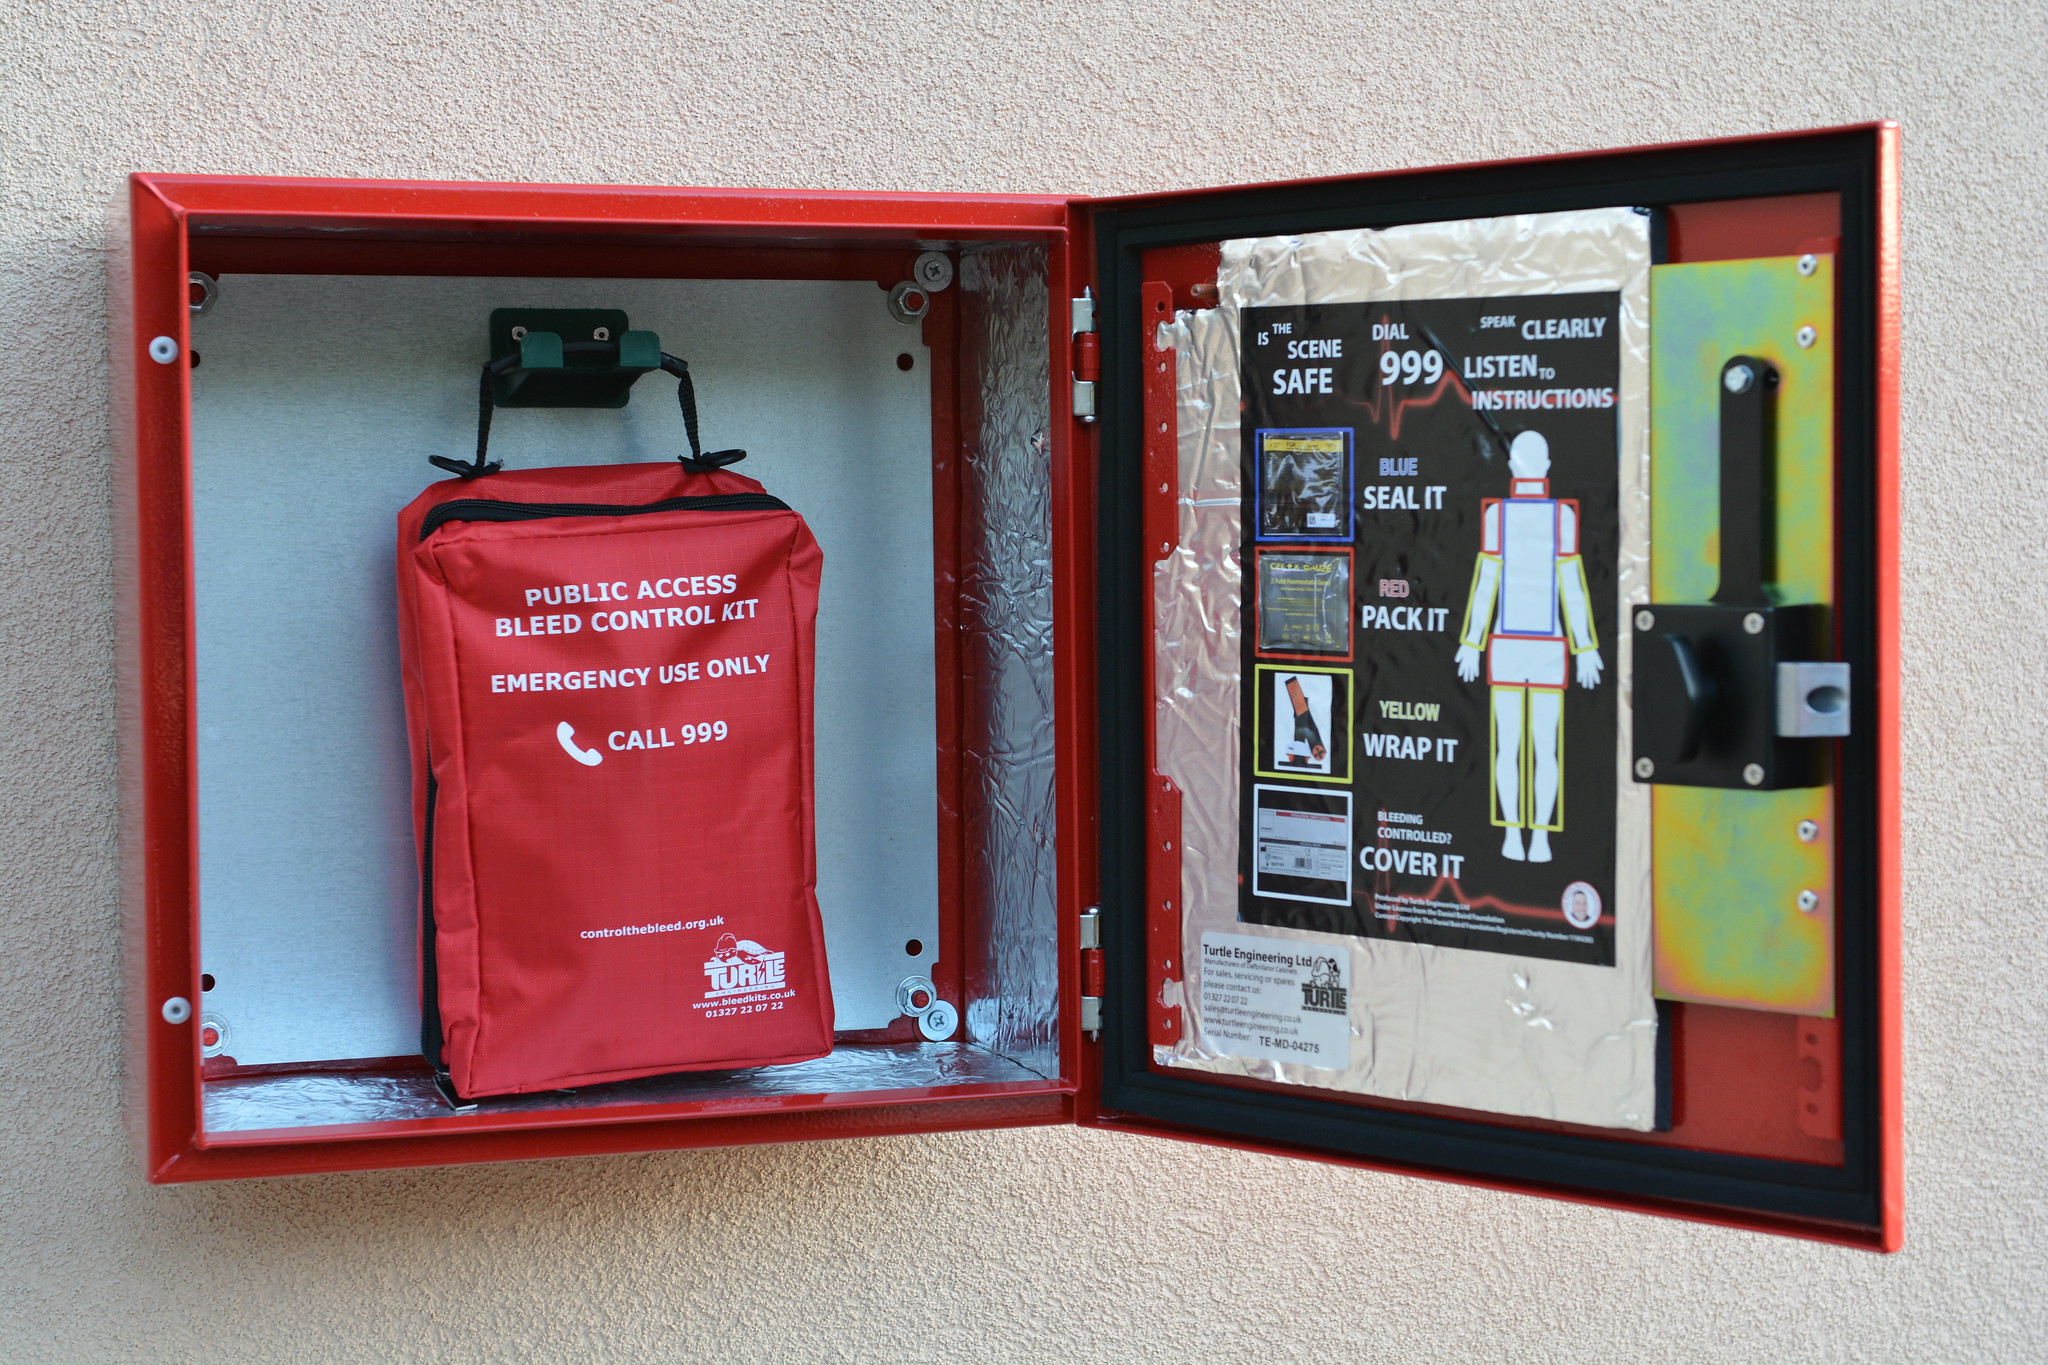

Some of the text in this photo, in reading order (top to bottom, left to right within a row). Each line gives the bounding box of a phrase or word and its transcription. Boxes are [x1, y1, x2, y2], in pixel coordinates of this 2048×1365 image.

[1257, 323, 1292, 346] IS THE
[1372, 323, 1409, 341] DIAL
[1480, 315, 1607, 341] SPEAK CLEARLY
[1287, 339, 1342, 359] SCENE
[1380, 349, 1444, 386] 999
[1463, 354, 1555, 381] LISTEN TO
[1272, 367, 1333, 396] SAFE
[1472, 387, 1614, 411] INSTRUCTIONS
[1379, 457, 1418, 476] BLUE
[1364, 485, 1447, 510] SEAL IT
[525, 574, 737, 607] PUBLIC ACCESS
[1379, 579, 1410, 598] RED
[495, 599, 758, 637] BLEED CONTROL KIT
[1362, 605, 1449, 632] PACK IT
[491, 654, 770, 693] EMERGENCY USE ONLY
[1379, 700, 1440, 722] YELLOW
[608, 720, 728, 751] CALL 999
[1363, 732, 1458, 763] WRAP IT
[1377, 810, 1423, 825] BLEEDING
[1377, 826, 1453, 845] CONTROLLED?
[1360, 846, 1437, 877] COVER
[1442, 854, 1465, 880] IT
[1374, 893, 1401, 902] Produced
[1402, 896, 1409, 904] by
[1409, 897, 1425, 905] Turtle
[1426, 899, 1460, 910] Engineering
[580, 915, 724, 939] controlthebleed.org.uk
[1203, 944, 1312, 968] Turtle Engineering Ltd
[1204, 957, 1239, 968] Manufacturers
[704, 957, 786, 990] TURTLE
[1203, 967, 1214, 976] For
[1215, 970, 1232, 979] sales,
[1234, 972, 1263, 984] servicing
[1273, 978, 1295, 987] spares
[1203, 980, 1262, 994] please contact us:
[1204, 992, 1248, 1005] 01327 22 07 22
[1302, 988, 1347, 1009] TURTLE
[692, 989, 795, 1009] www.bleedkits.co.uk
[706, 1001, 784, 1018] 01327 22 07 22
[1204, 1004, 1302, 1023] sales@turtleengineering.co.uk
[1204, 1017, 1298, 1035] www.turtleengineering.co.uk
[1204, 1027, 1320, 1053] Serial Number: TE-MD-04275
